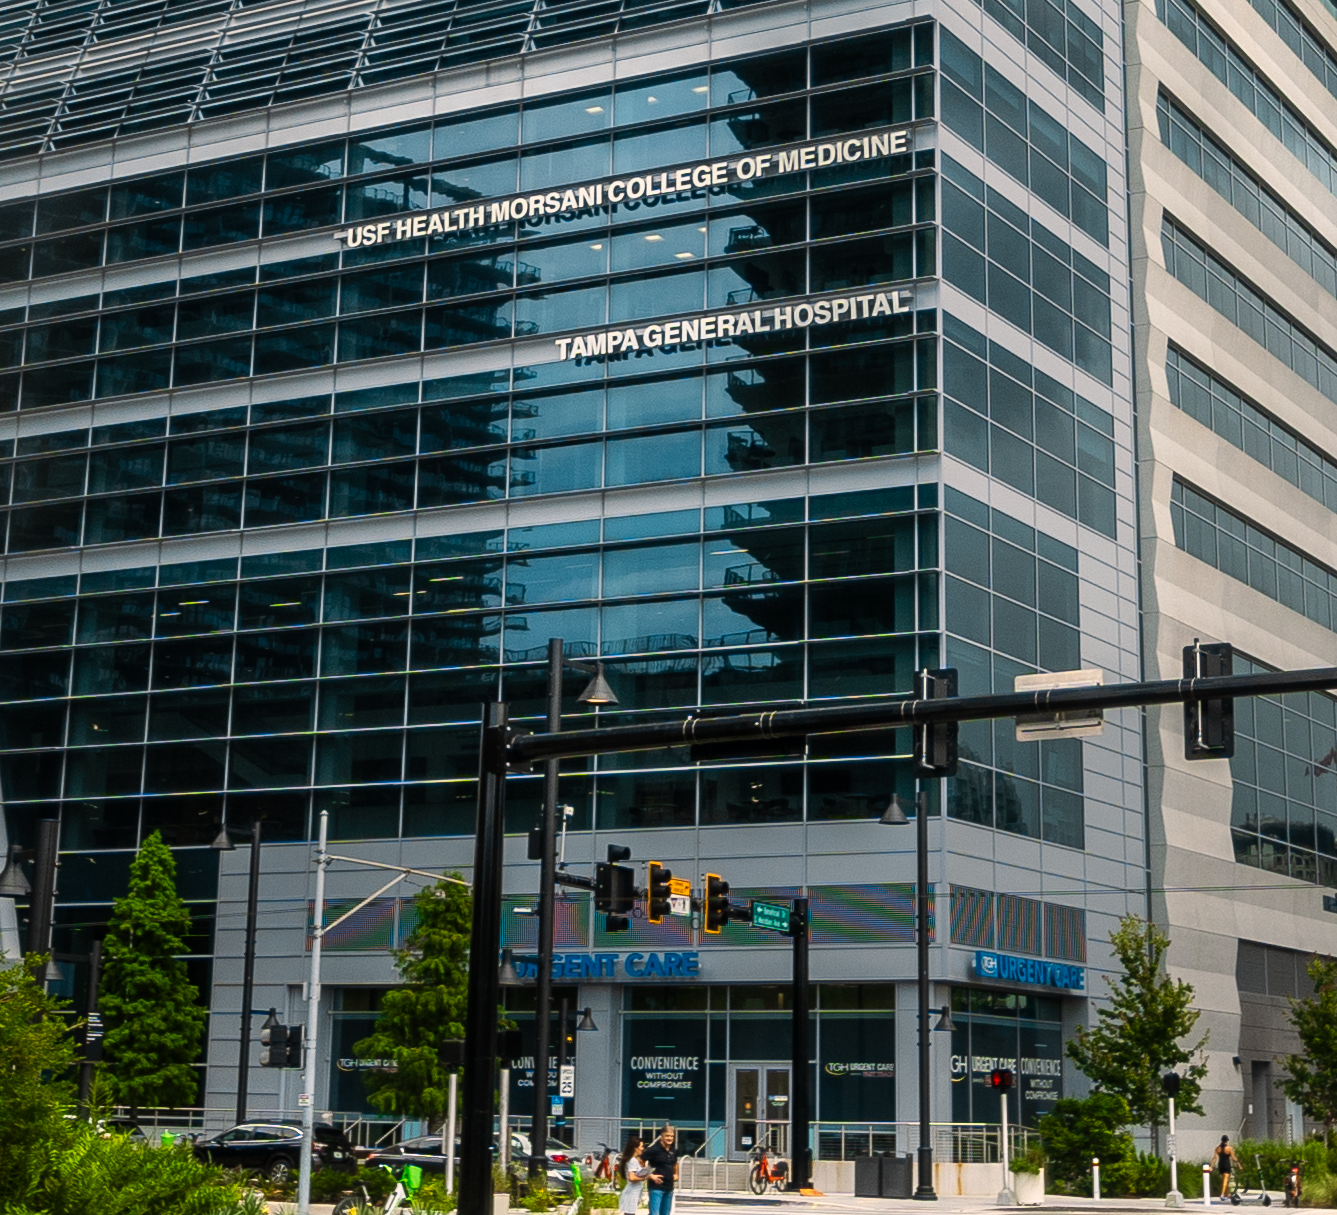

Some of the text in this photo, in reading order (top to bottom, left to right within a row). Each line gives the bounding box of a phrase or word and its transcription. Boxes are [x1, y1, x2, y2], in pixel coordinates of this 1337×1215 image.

[346, 130, 909, 249] USF HEALTH MORSANI COLLEGE OF MEDICINE
[555, 290, 910, 361] TAMPA GENERAL HOSPITAL
[624, 952, 699, 977] CARE
[1000, 955, 1053, 985] URGENT
[1055, 966, 1085, 990] CARE
[339, 1058, 358, 1067] TGH
[630, 1056, 699, 1070] CONVENIENCE
[829, 1062, 849, 1071] TGH
[850, 1062, 875, 1071] URGENT
[971, 1056, 999, 1073] URGENT
[1020, 1057, 1061, 1076] CONVENIENCE
[637, 1080, 693, 1089] COMPROMISE
[645, 1072, 684, 1080] WITHOUT
